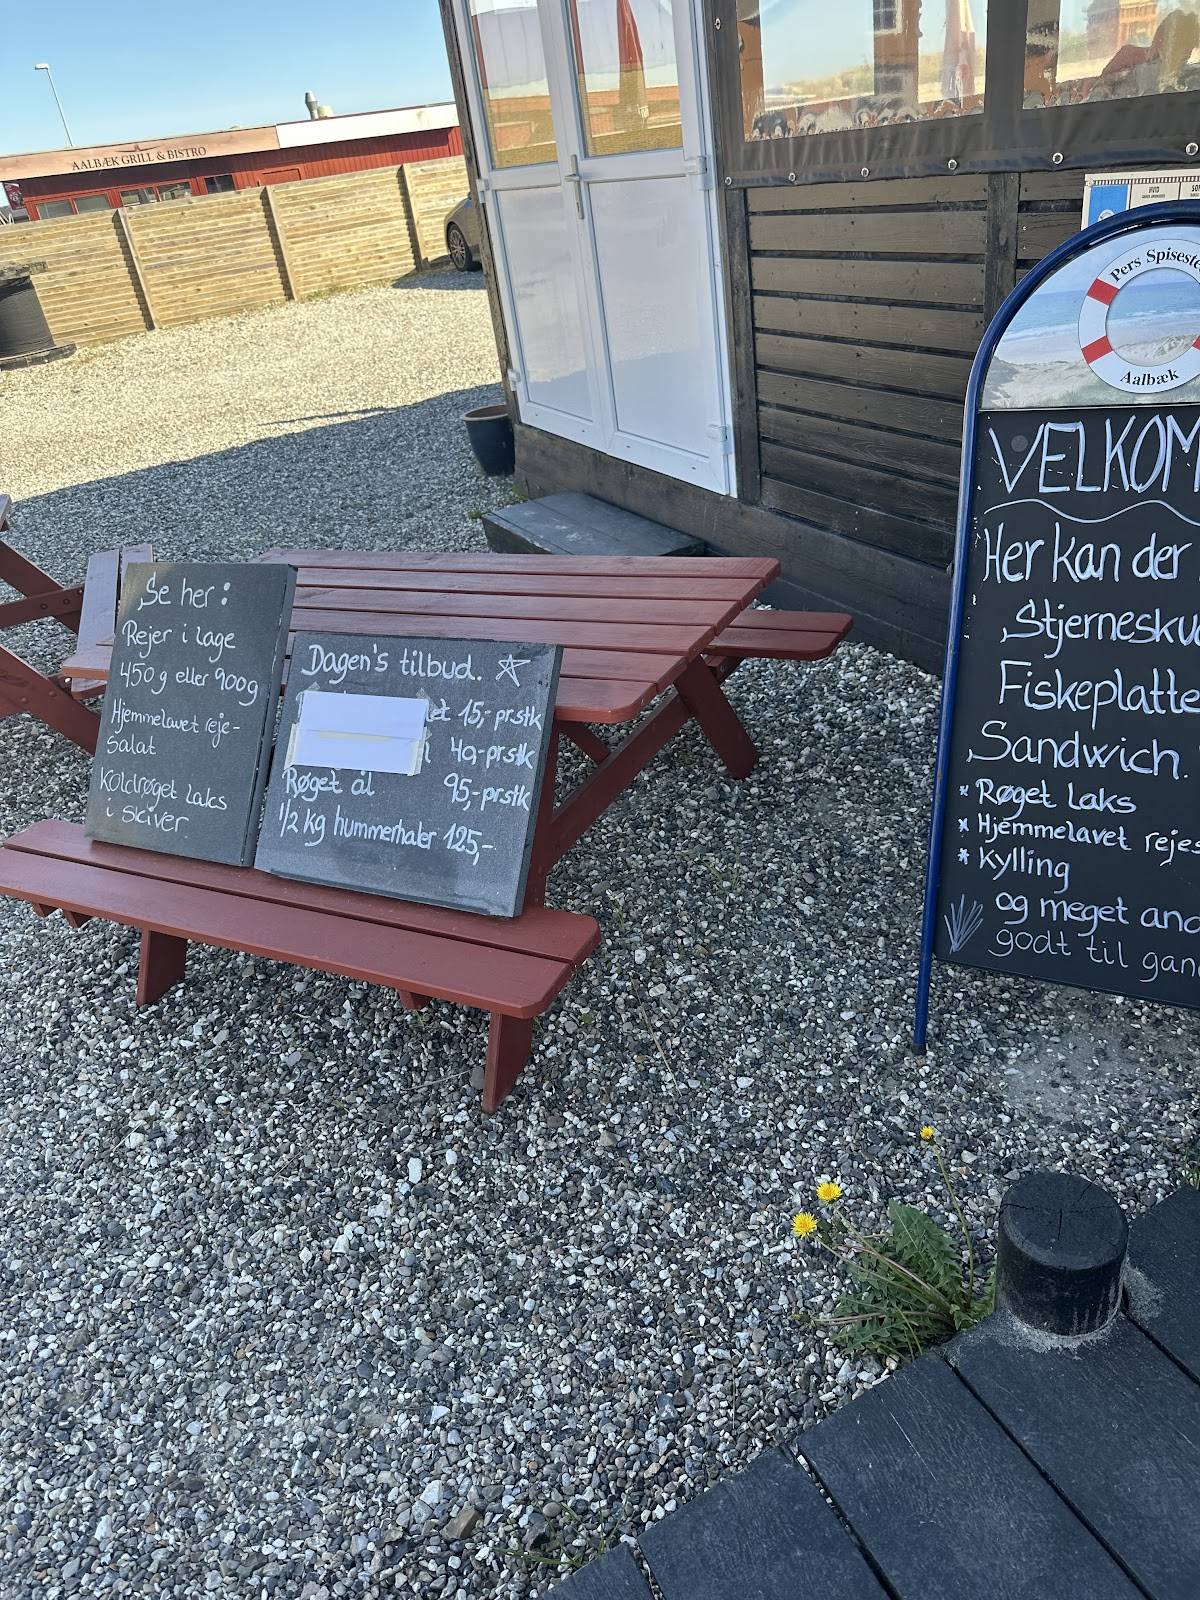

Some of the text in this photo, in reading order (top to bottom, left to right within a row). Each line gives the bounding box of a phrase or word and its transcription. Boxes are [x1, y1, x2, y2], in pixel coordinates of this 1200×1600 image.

[72, 146, 207, 171] AALBÆK GRILL & BISTRO
[1109, 256, 1142, 282] Pers
[1119, 369, 1180, 386] Aalbæk
[983, 522, 1193, 584] Her kan der
[137, 571, 172, 611] Se
[121, 619, 173, 659] Rejer
[182, 623, 189, 644] i
[120, 661, 155, 689] 450
[175, 666, 210, 686] eller
[300, 643, 483, 685] Dagen's tilbud.
[111, 698, 241, 749] Hjemmelavet reje-
[966, 720, 1189, 780] Sandwich.
[281, 766, 344, 802] Røget
[350, 770, 376, 797] ål
[975, 778, 1058, 821] Røget
[106, 797, 114, 817] i
[278, 798, 299, 838] 1/2
[333, 804, 437, 850] hummerhaler
[977, 812, 1133, 851] Hjemmelavet
[1040, 896, 1130, 937] meget
[988, 928, 1200, 983] godt til gan
